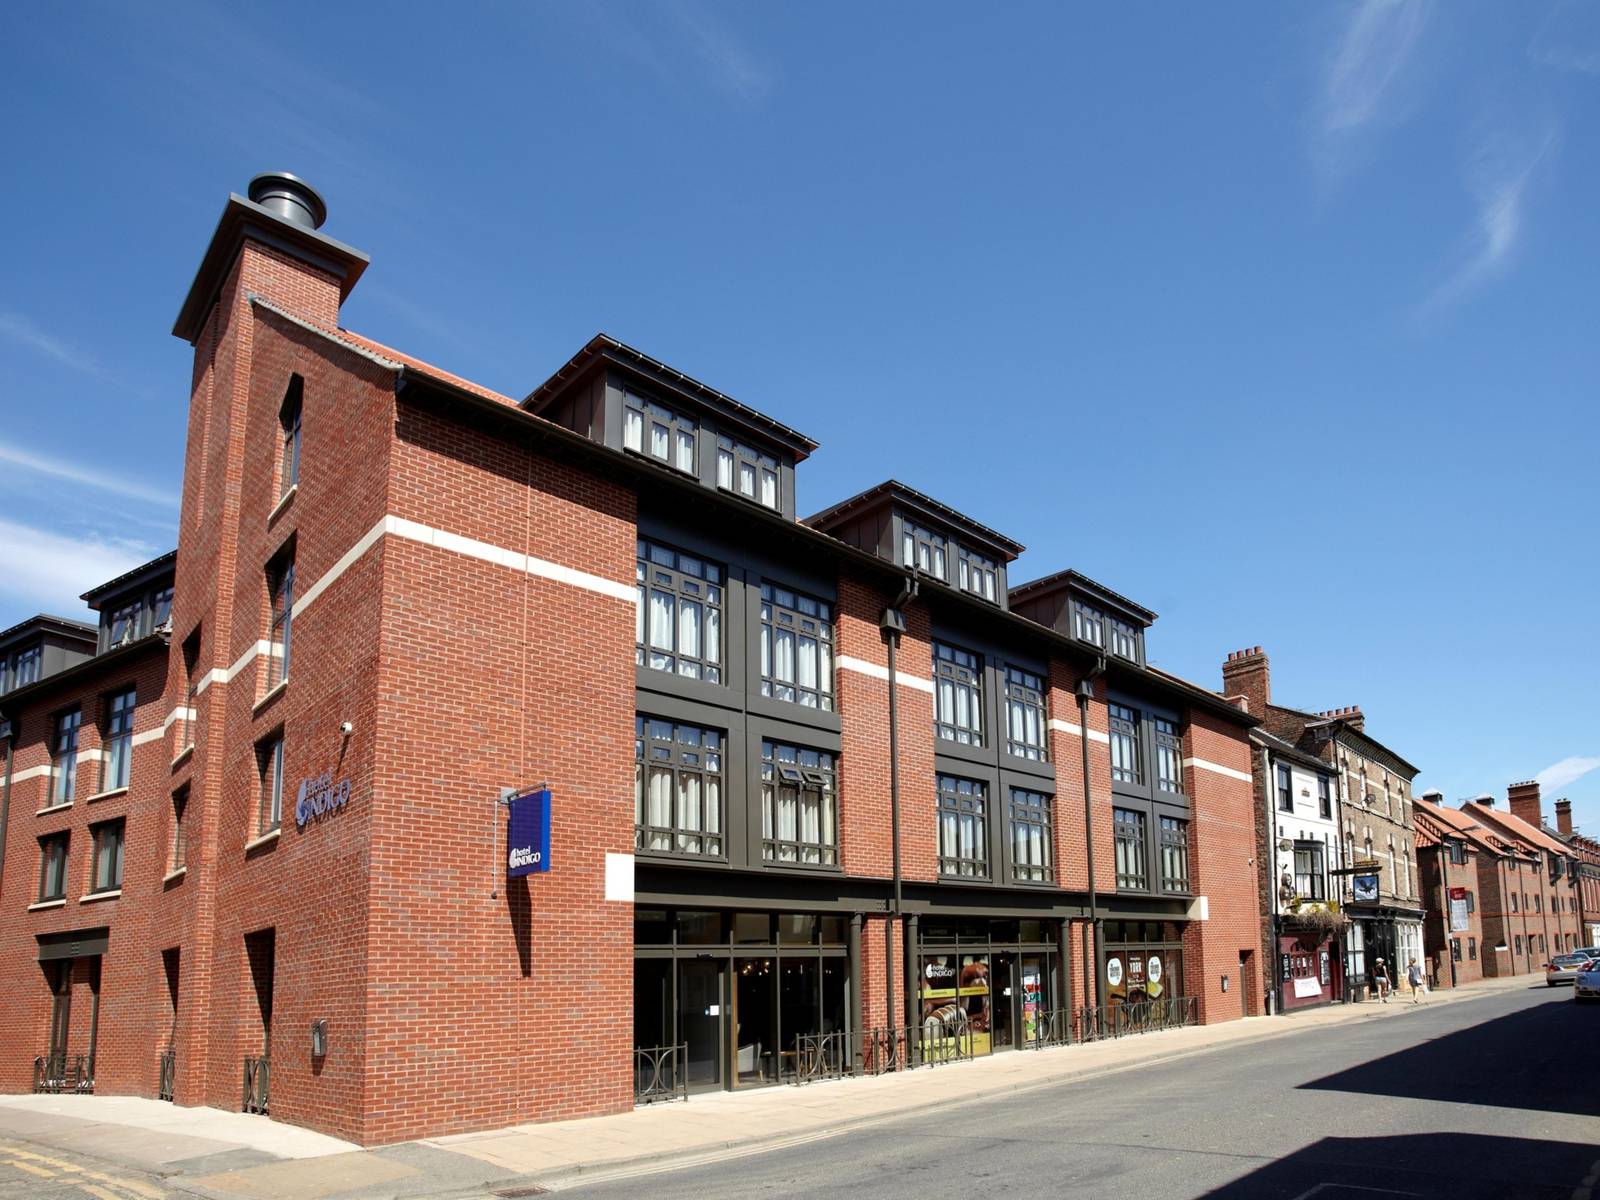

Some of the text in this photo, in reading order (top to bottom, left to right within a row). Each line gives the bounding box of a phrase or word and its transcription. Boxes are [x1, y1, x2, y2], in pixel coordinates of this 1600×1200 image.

[306, 778, 351, 820] INDIGO
[516, 845, 531, 857] hotel
[514, 852, 541, 867] INDIGO
[931, 969, 953, 977] INDIGO
